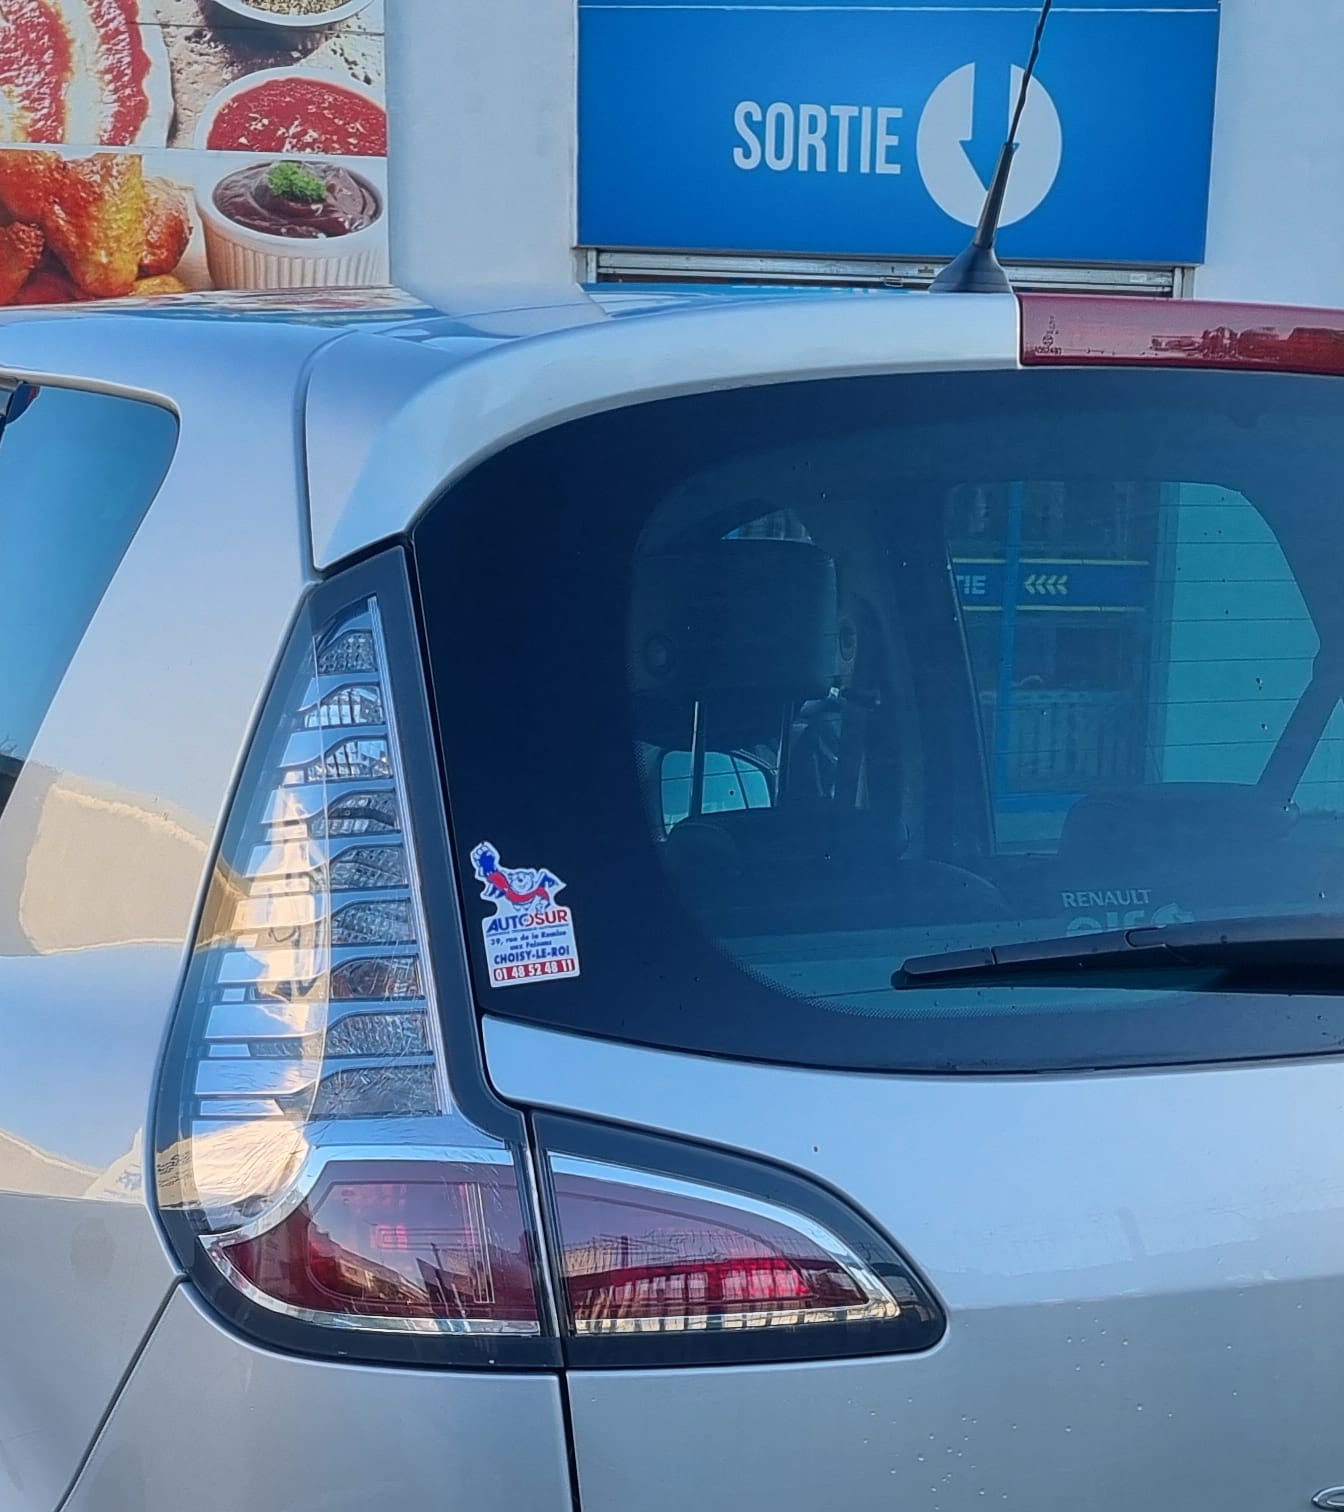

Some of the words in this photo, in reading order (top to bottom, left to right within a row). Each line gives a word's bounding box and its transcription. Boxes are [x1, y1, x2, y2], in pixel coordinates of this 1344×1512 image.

[733, 101, 903, 174] SORTIE
[1061, 889, 1152, 907] RENAULT
[486, 909, 568, 934] AUTOSUR
[494, 945, 570, 965] CHOISY-LE-ROI
[495, 968, 508, 980] 01
[511, 966, 526, 978] 48
[528, 963, 542, 976] 52
[544, 961, 558, 974] 48
[561, 959, 573, 972] 11
